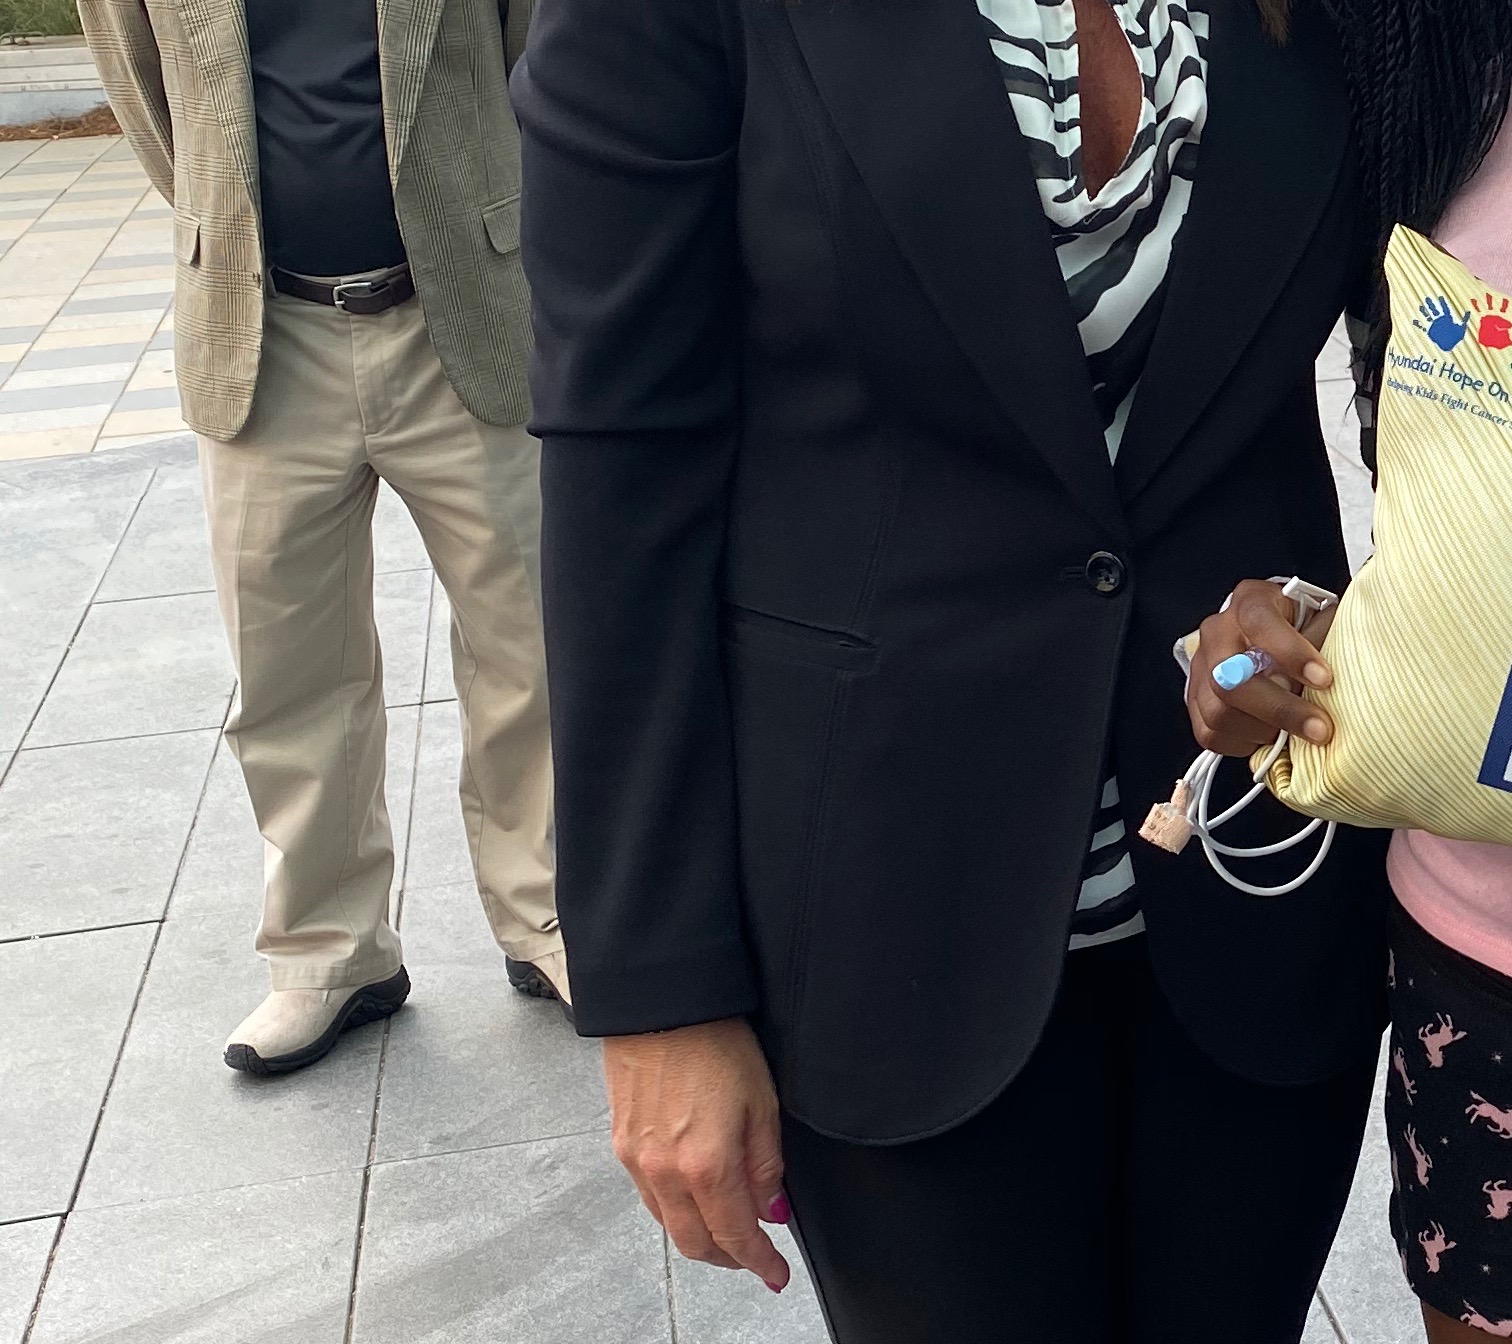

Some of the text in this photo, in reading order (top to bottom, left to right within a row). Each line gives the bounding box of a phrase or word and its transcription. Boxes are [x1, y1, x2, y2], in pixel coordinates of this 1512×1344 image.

[1387, 346, 1438, 377] Hyundai
[1439, 361, 1484, 392] Hope
[1488, 381, 1510, 404] On
[1415, 386, 1438, 401] Kids
[1440, 393, 1469, 411] Fight
[1470, 404, 1508, 426] Cancer
